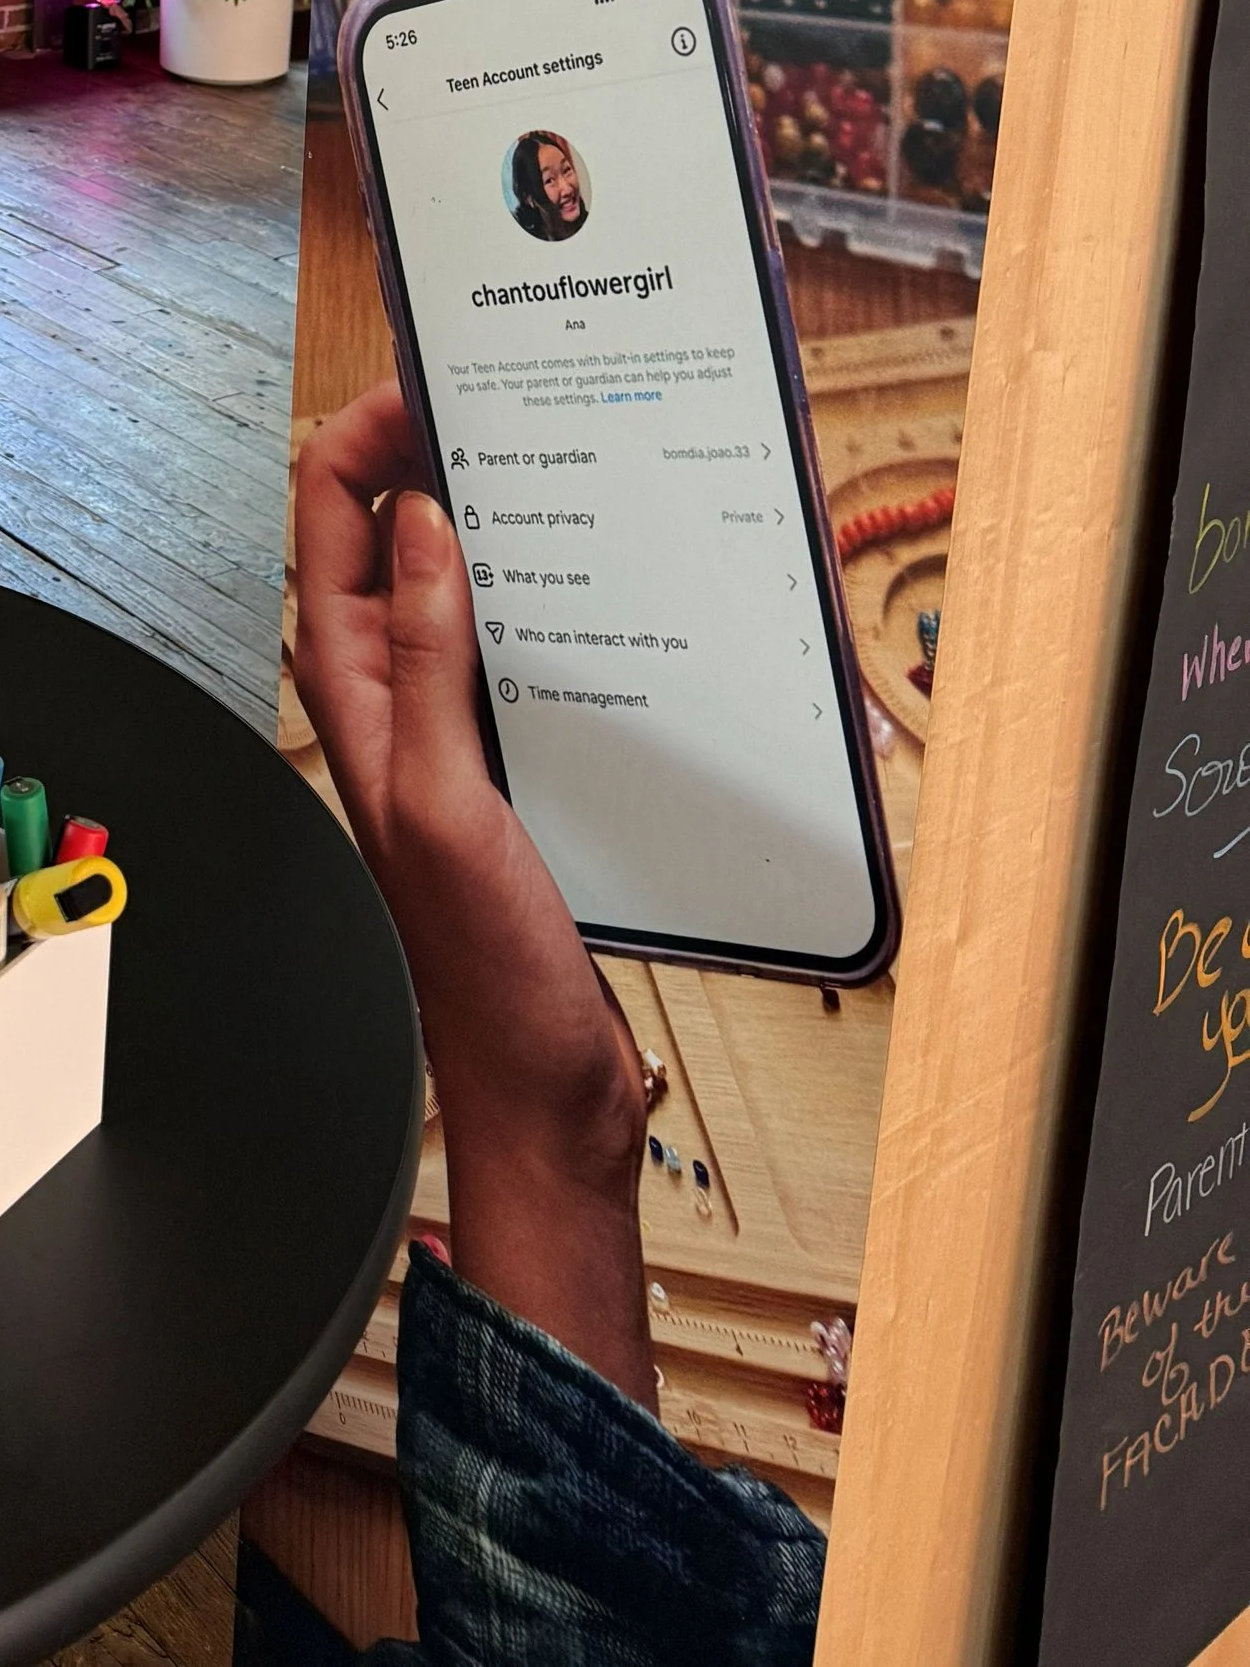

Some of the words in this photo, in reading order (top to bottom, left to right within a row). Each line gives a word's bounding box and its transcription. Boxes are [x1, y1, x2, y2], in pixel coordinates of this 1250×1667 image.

[385, 29, 418, 50] 5:26
[446, 76, 480, 94] Teen
[482, 62, 540, 87] Account
[542, 51, 604, 75] settings
[471, 265, 674, 308] chantouflowergirl
[564, 319, 586, 331] Ana
[447, 363, 470, 376] Your
[471, 362, 496, 374] Teen
[498, 359, 539, 373] Account
[541, 357, 576, 369] comes
[577, 354, 601, 367] with
[603, 352, 642, 367] built-in
[643, 349, 689, 364] settings
[691, 348, 705, 361] to
[705, 347, 736, 363] keep
[456, 382, 475, 396] you
[477, 379, 500, 392] safe.
[501, 379, 524, 390] Your
[526, 376, 559, 391] parent
[561, 376, 573, 387] or
[575, 372, 623, 389] guardian
[624, 373, 645, 384] can
[646, 370, 672, 385] help
[673, 369, 695, 385] you
[697, 366, 734, 382] adjust
[522, 395, 551, 407] these
[553, 392, 599, 407] settings.
[601, 391, 633, 404] Learn
[634, 390, 663, 402] more
[478, 451, 520, 466] Parent
[522, 453, 535, 465] or
[539, 449, 598, 469] guardian
[492, 510, 545, 525] Account
[547, 510, 595, 529] privacy
[721, 510, 764, 524] Private
[502, 568, 538, 584] What
[539, 572, 564, 588] you
[566, 573, 591, 586] see
[515, 627, 546, 644] Who
[548, 631, 572, 644] can
[573, 629, 627, 647] interact
[628, 632, 660, 649] with
[661, 635, 689, 653] you
[527, 685, 561, 702] Time
[563, 689, 649, 709] management
[1098, 1231, 1236, 1374] Beware
[1142, 1321, 1191, 1407] of
